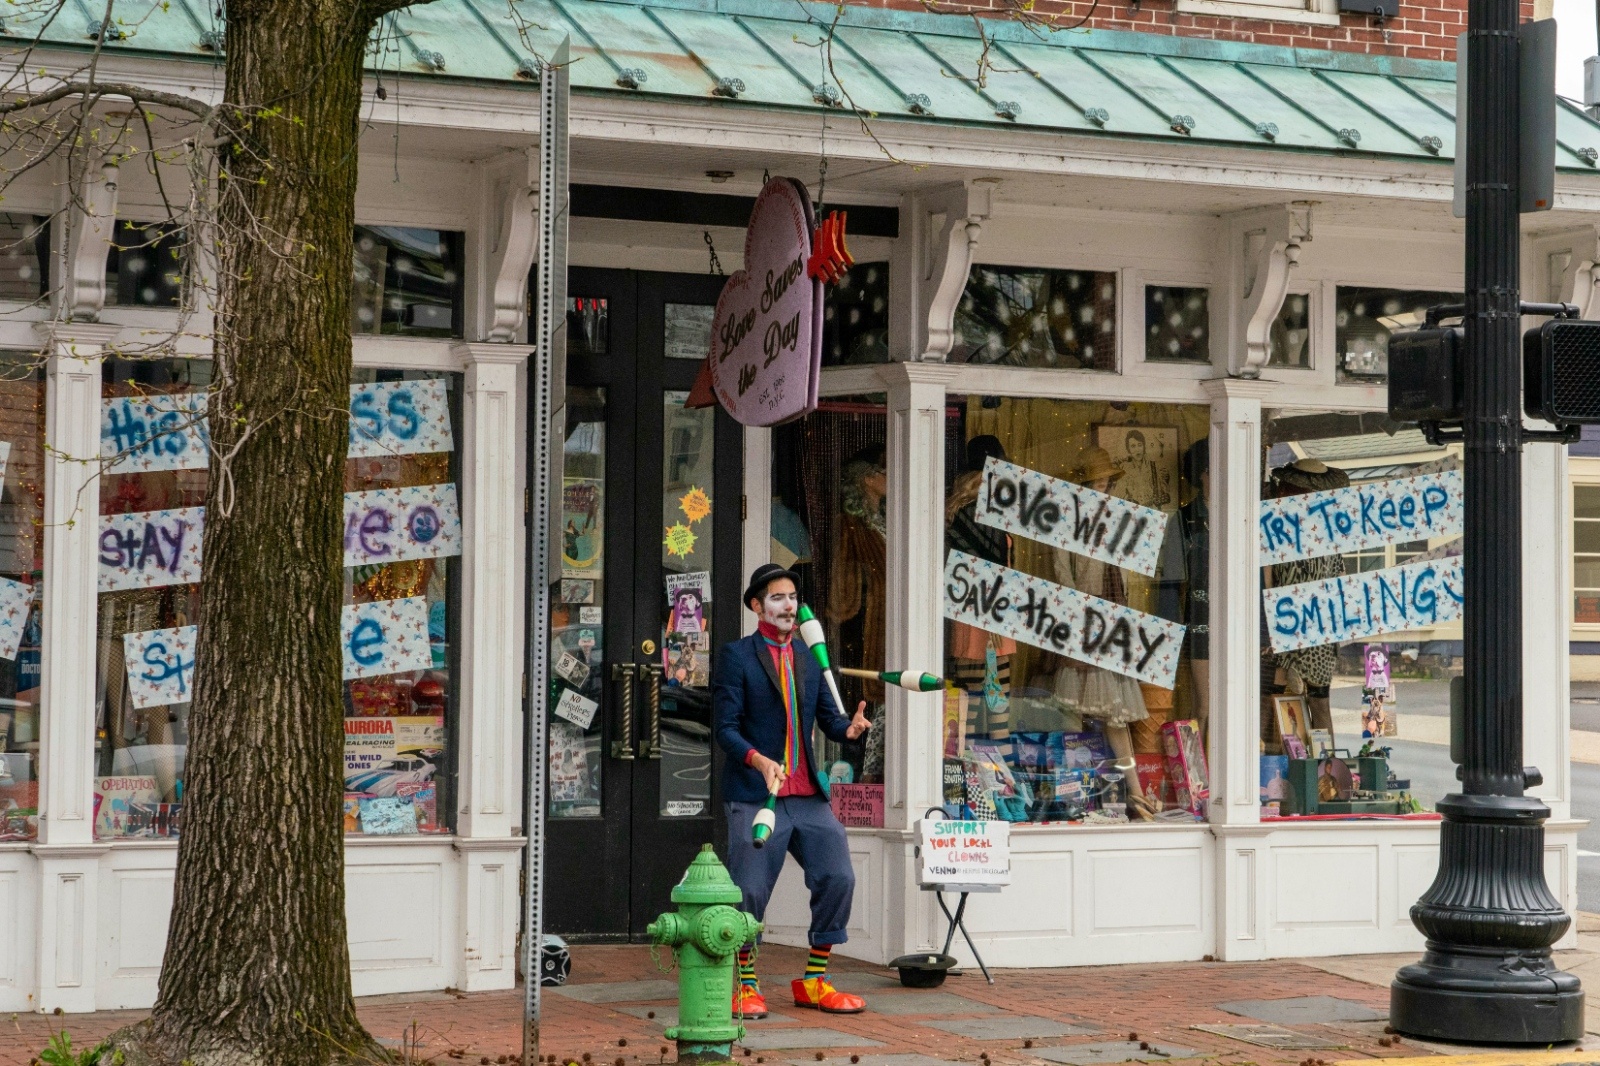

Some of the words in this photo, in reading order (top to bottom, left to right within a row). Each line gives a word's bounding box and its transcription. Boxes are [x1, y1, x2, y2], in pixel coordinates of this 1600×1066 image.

[719, 307, 756, 363] Love
[760, 252, 804, 314] Saves
[737, 362, 757, 398] the
[763, 312, 801, 369] Day
[1260, 511, 1303, 554] TRY
[1017, 587, 1071, 650] the
[1081, 606, 1166, 673] DAY
[21, 663, 41, 675] DOCTO
[944, 765, 962, 774] FRANK
[101, 778, 156, 791] OPERATION
[832, 786, 840, 798] No
[865, 786, 883, 803] Eating
[839, 799, 846, 811] Or
[847, 799, 873, 815] Screwing
[839, 812, 846, 824] On
[934, 821, 987, 835] SUPPORT
[929, 837, 956, 850] YOUR
[963, 837, 992, 849] LOCAL
[947, 851, 989, 864] CLOWNS
[929, 866, 957, 875] VENMO
